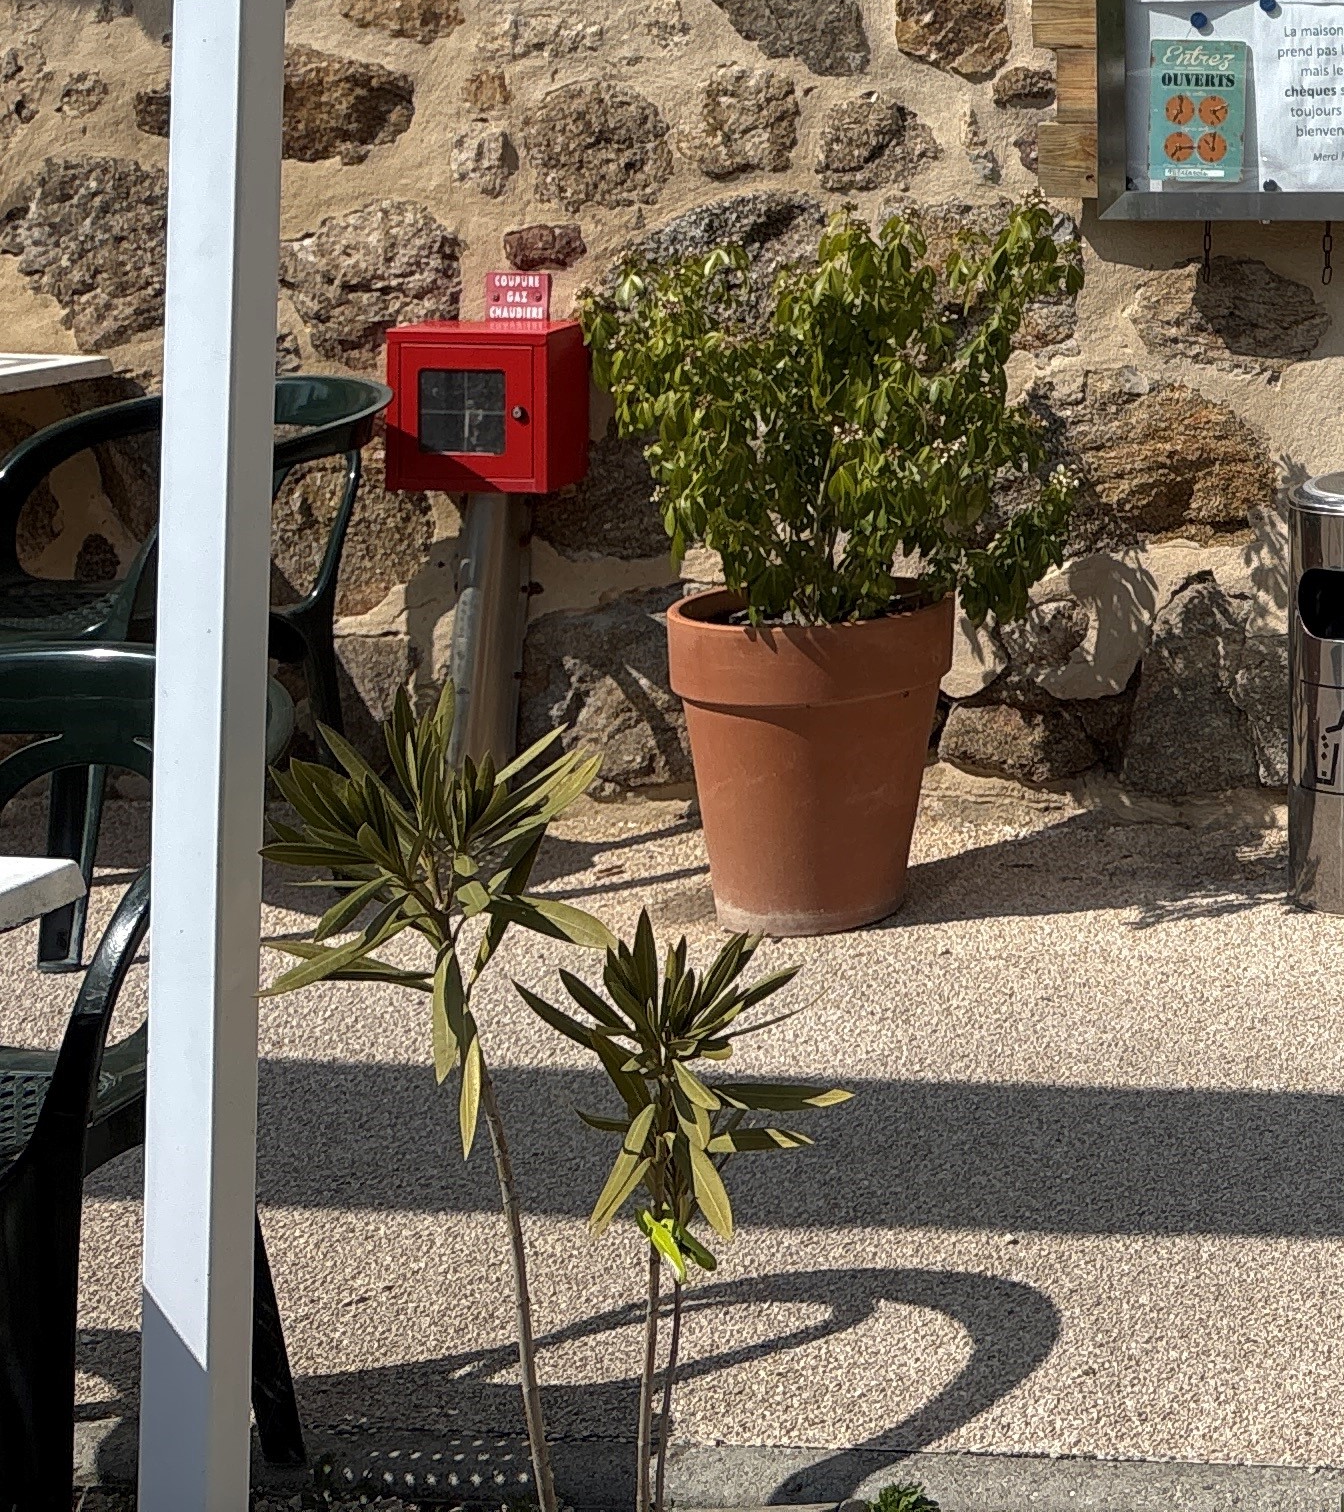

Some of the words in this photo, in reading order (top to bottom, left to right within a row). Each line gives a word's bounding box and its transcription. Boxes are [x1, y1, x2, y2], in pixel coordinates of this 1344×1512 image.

[1283, 25, 1297, 37] La
[1300, 24, 1344, 37] maison
[1162, 45, 1236, 71] Entrez
[1277, 44, 1313, 60] prend
[1316, 47, 1338, 59] pas
[1300, 64, 1330, 77] mais
[1161, 72, 1236, 88] OUVERTS
[1284, 85, 1337, 99] chèques
[1290, 105, 1342, 119] toujours
[1312, 151, 1339, 162] Merci
[494, 275, 540, 288] COUPURE
[506, 290, 528, 303] GAZ
[489, 306, 543, 319] CHAUDIERE
